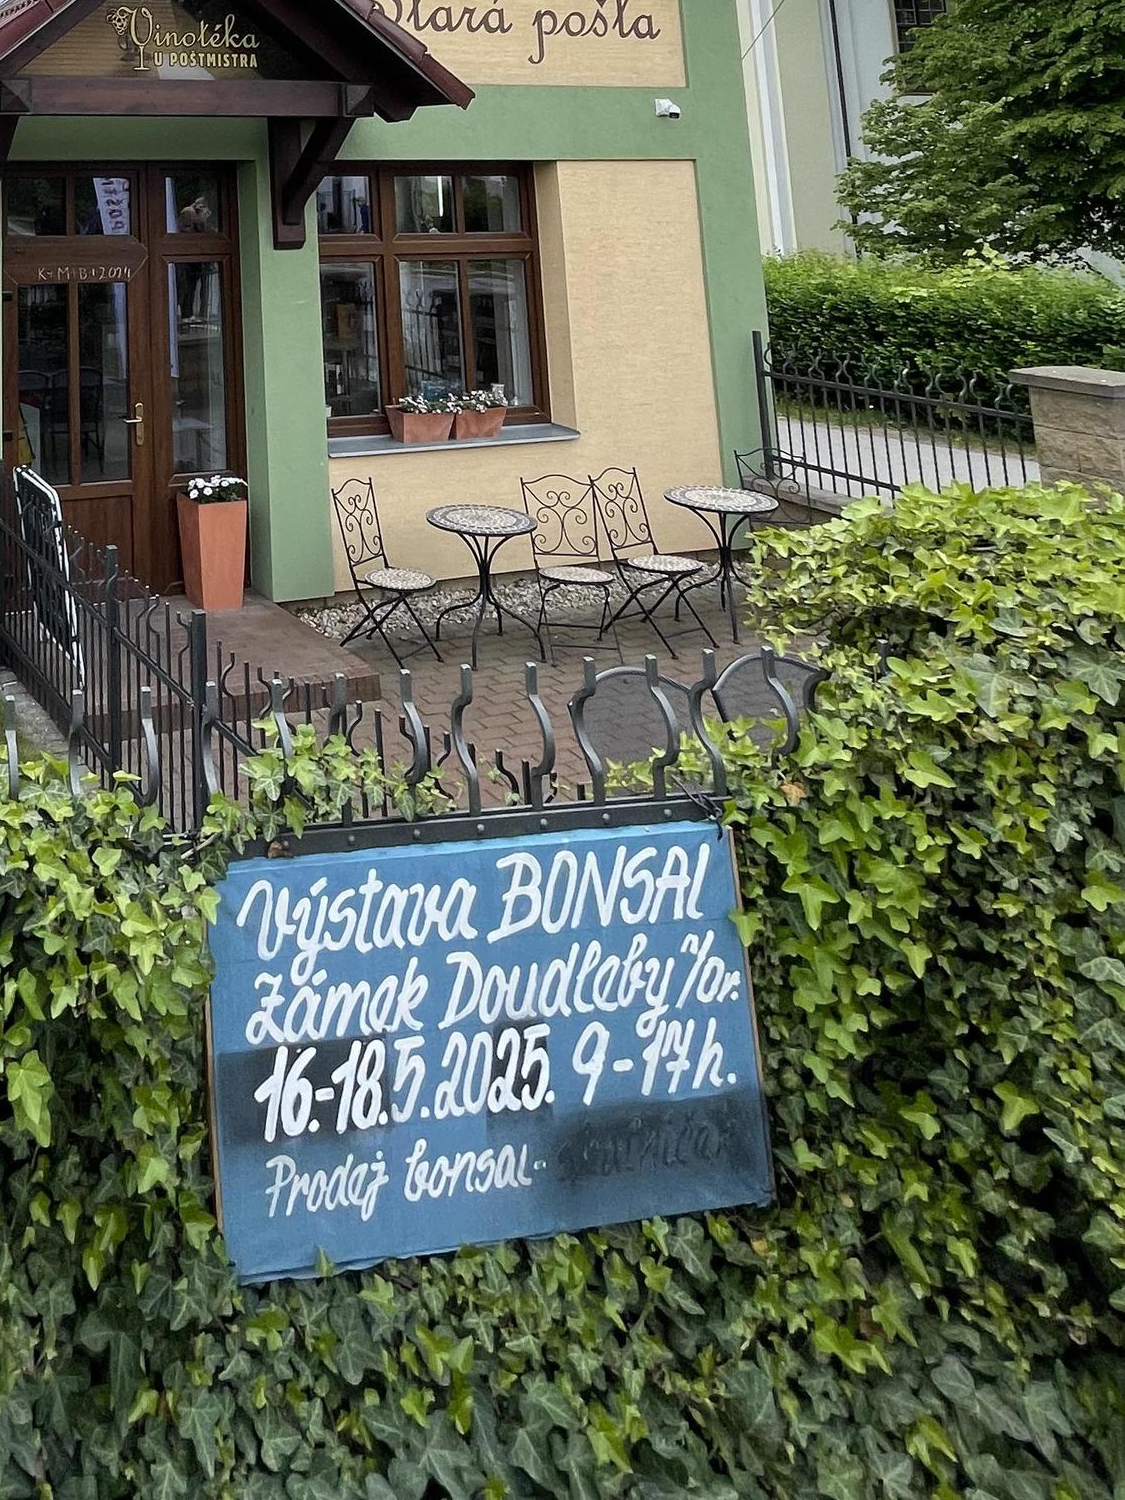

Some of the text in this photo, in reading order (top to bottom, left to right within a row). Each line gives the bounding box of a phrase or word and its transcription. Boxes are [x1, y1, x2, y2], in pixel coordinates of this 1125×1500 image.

[116, 4, 261, 71] Vinotéka
[154, 50, 259, 69] U POŠTMISTRA
[236, 842, 711, 987] Výstava BONSAI
[437, 932, 676, 1038] Doudleby
[265, 1150, 389, 1222] Prodej
